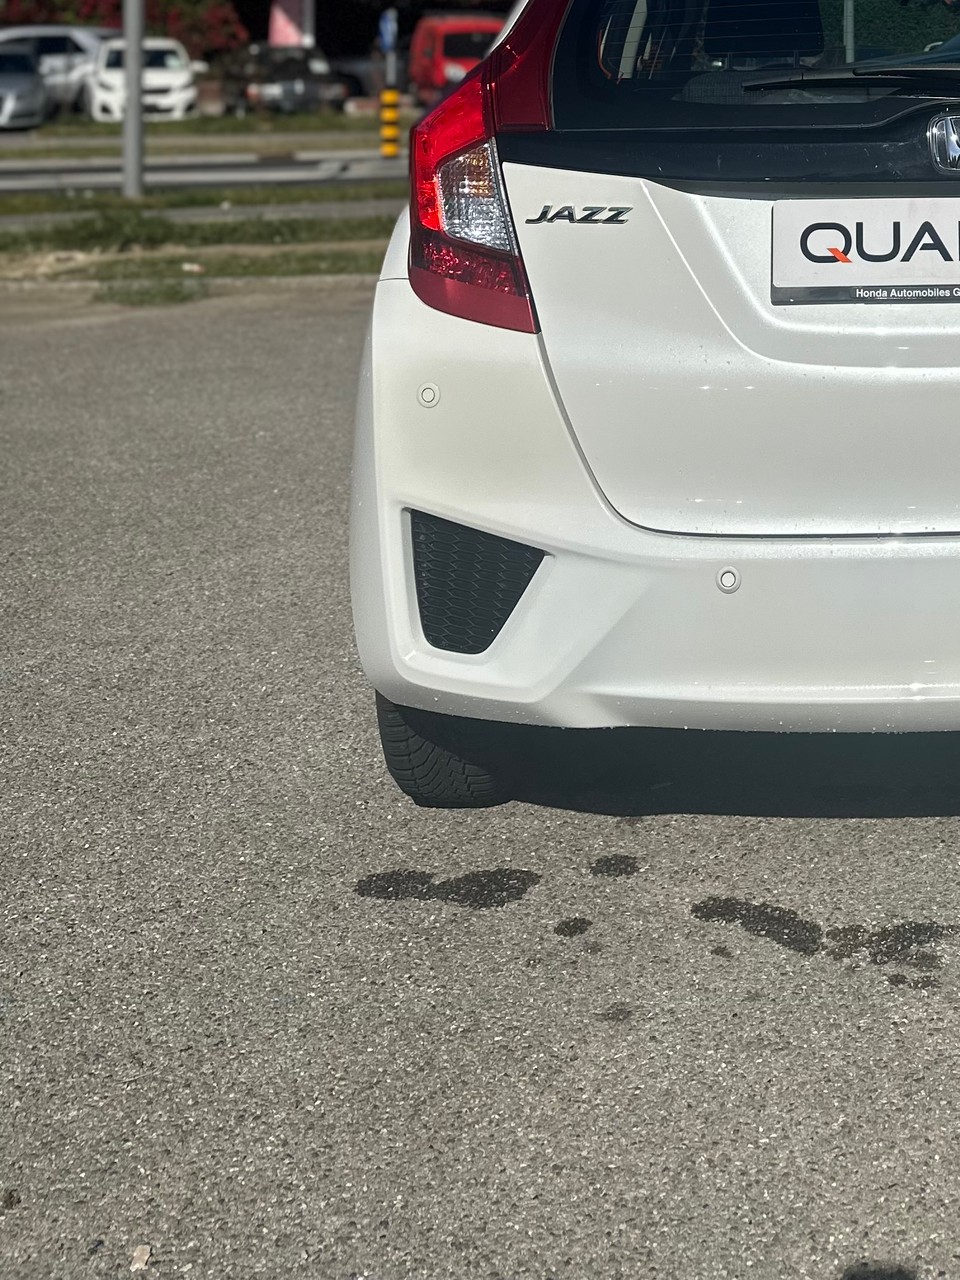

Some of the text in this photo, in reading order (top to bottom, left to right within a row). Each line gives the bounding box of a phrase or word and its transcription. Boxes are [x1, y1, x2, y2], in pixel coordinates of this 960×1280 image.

[525, 205, 633, 224] JAZZ
[856, 289, 888, 298] Honda
[890, 288, 950, 297] Automobiles
